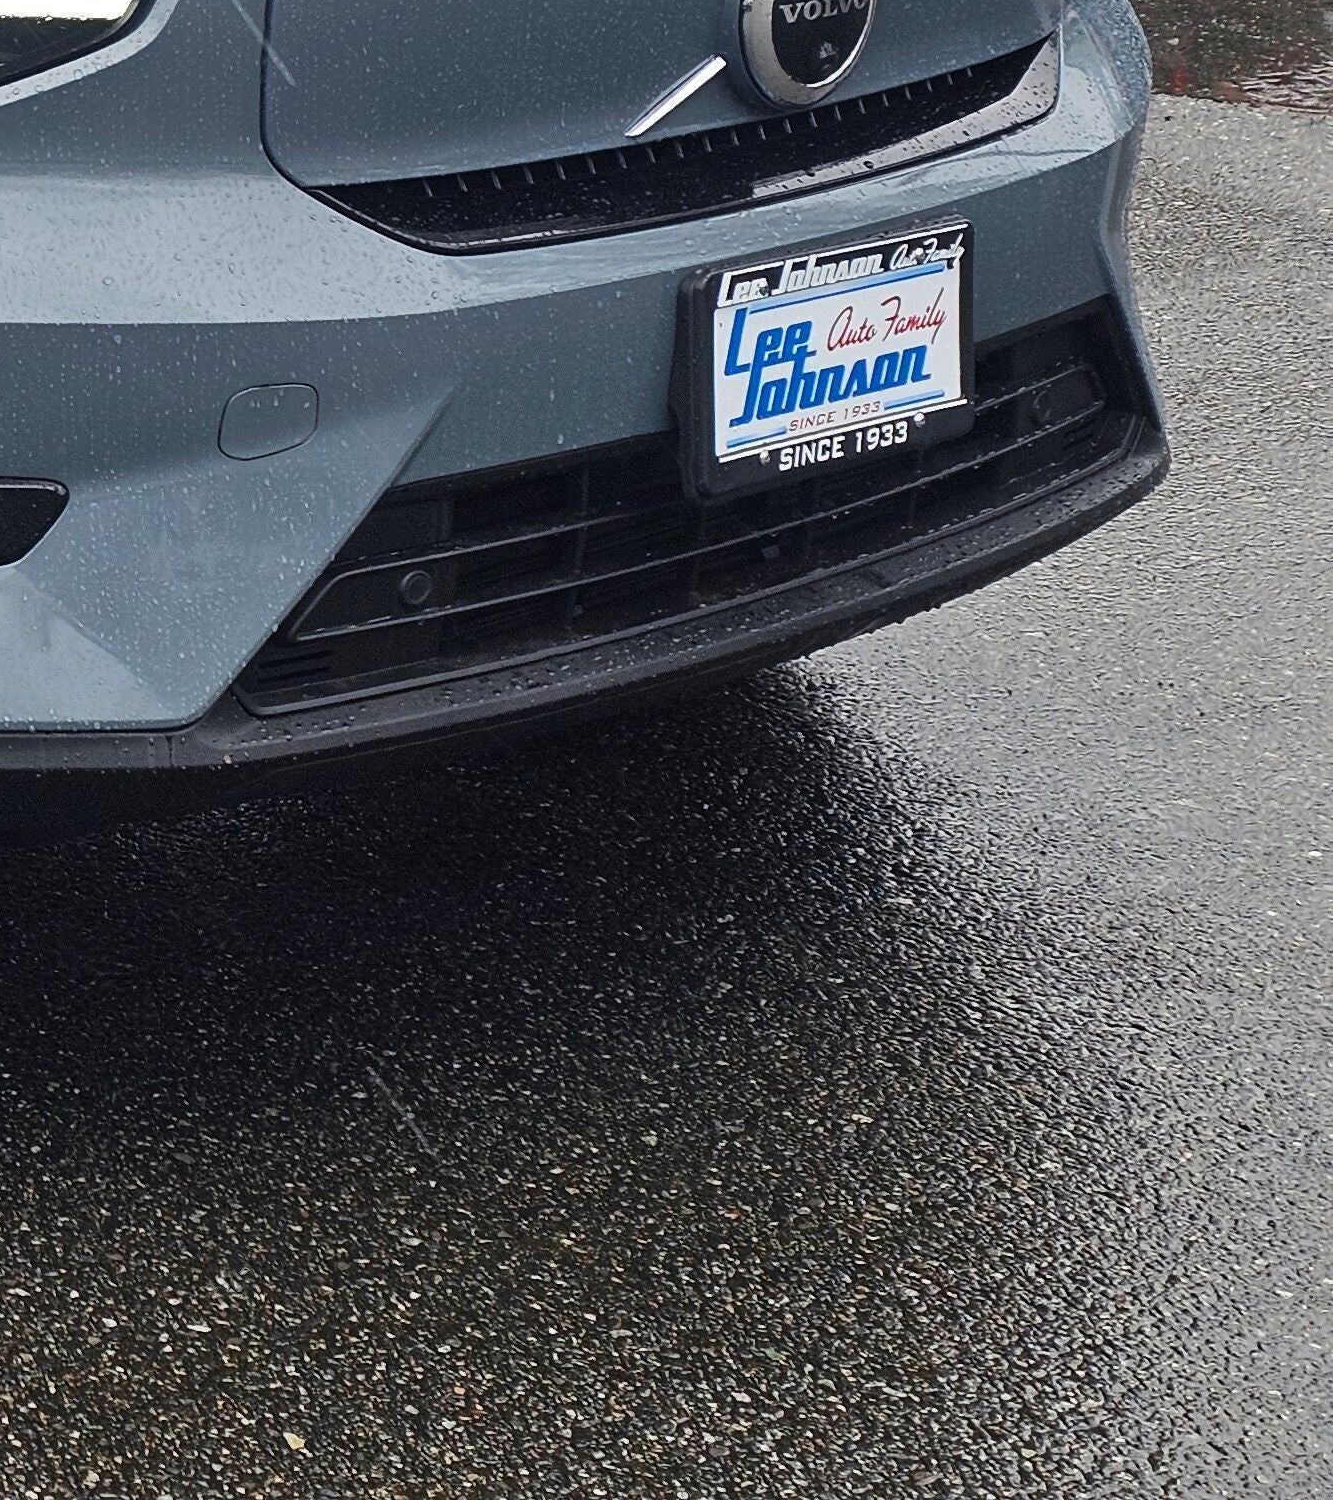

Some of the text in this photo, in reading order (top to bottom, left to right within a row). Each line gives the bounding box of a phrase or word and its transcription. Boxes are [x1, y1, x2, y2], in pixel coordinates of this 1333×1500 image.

[716, 271, 770, 308] Lee
[771, 253, 885, 297] Johnson
[724, 286, 947, 376] Lee Auto Family
[729, 345, 931, 428] Johnson
[789, 401, 881, 431] SINCE 1933
[779, 420, 908, 472] SINCE 1933
